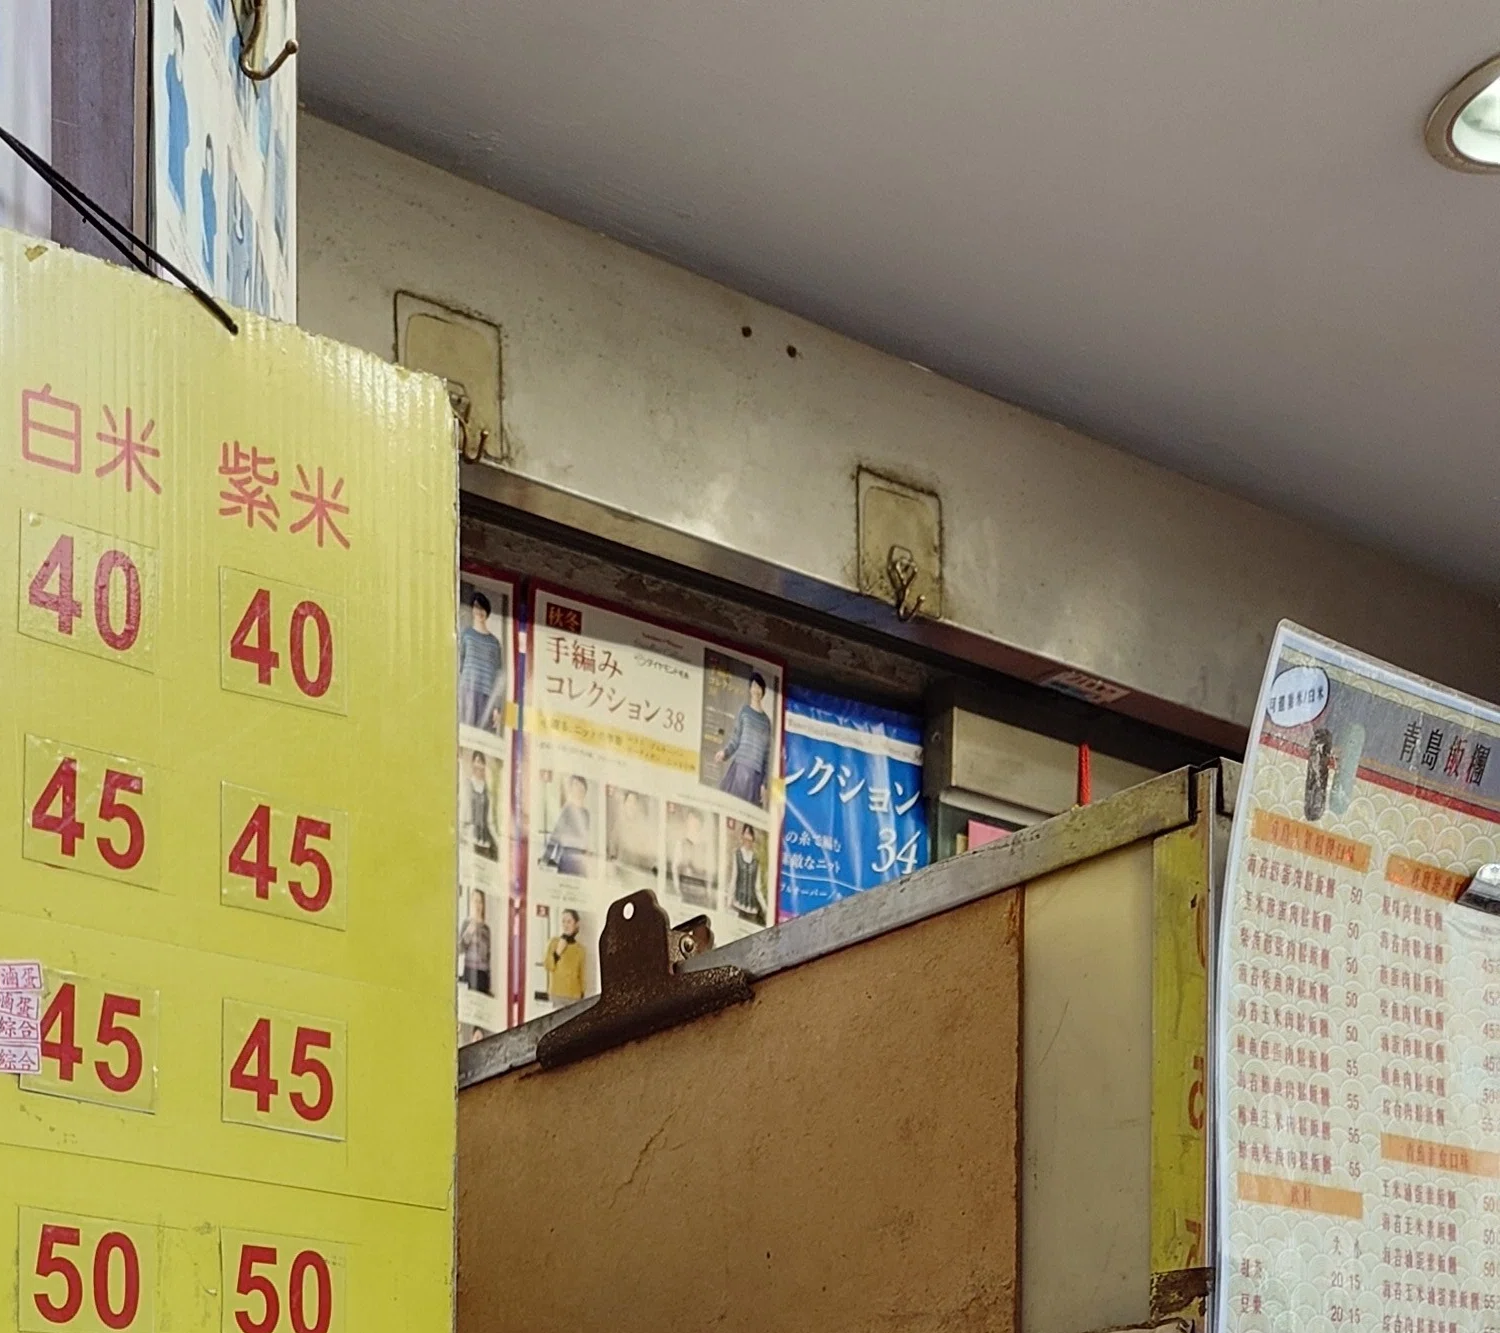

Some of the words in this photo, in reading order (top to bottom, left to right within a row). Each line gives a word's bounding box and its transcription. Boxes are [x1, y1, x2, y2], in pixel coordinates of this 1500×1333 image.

[20, 383, 162, 495] 白米
[218, 439, 352, 550] 紫米
[28, 534, 143, 653] 40
[230, 589, 332, 697] 40
[547, 637, 623, 679] 手編み
[546, 675, 660, 722] コレクション
[662, 708, 686, 733] 38
[1399, 720, 1491, 788] 青島飯糰
[32, 758, 144, 870] 45
[228, 805, 332, 912] 45
[872, 828, 921, 875] 34
[41, 984, 142, 1093] 45
[229, 1018, 333, 1122] 45
[34, 1225, 139, 1329] 50
[1331, 1271, 1343, 1288] 20
[1350, 1274, 1361, 1290] 15
[1331, 1306, 1343, 1322] 20
[1350, 1308, 1361, 1324] 15
